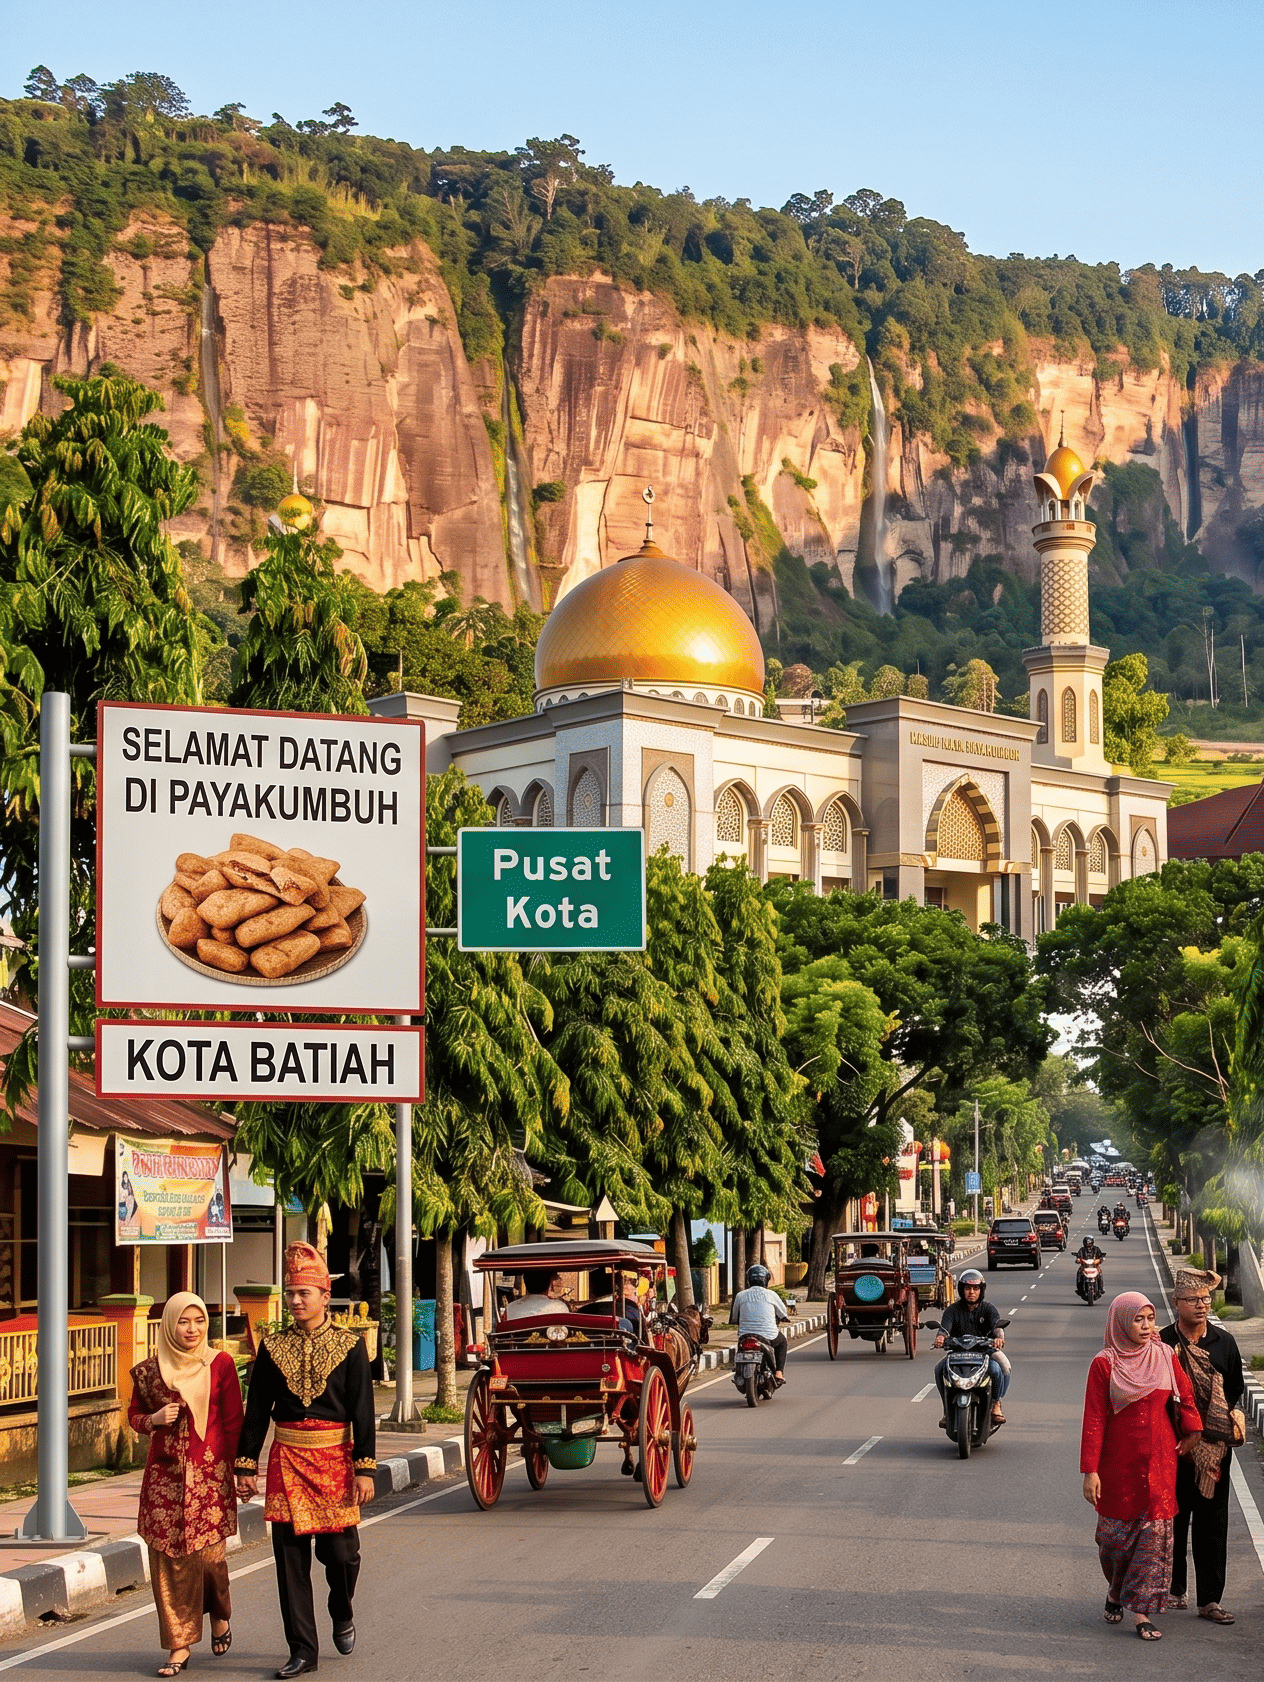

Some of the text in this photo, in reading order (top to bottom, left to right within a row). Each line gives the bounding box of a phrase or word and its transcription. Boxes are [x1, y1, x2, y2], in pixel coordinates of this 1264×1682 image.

[122, 726, 402, 775] SELAMAT DATANG
[125, 776, 398, 825] DI PAYAKUMBUH
[494, 849, 611, 881] Pusat
[507, 896, 599, 929] Kota
[127, 1038, 395, 1085] KOTA BATIAH
